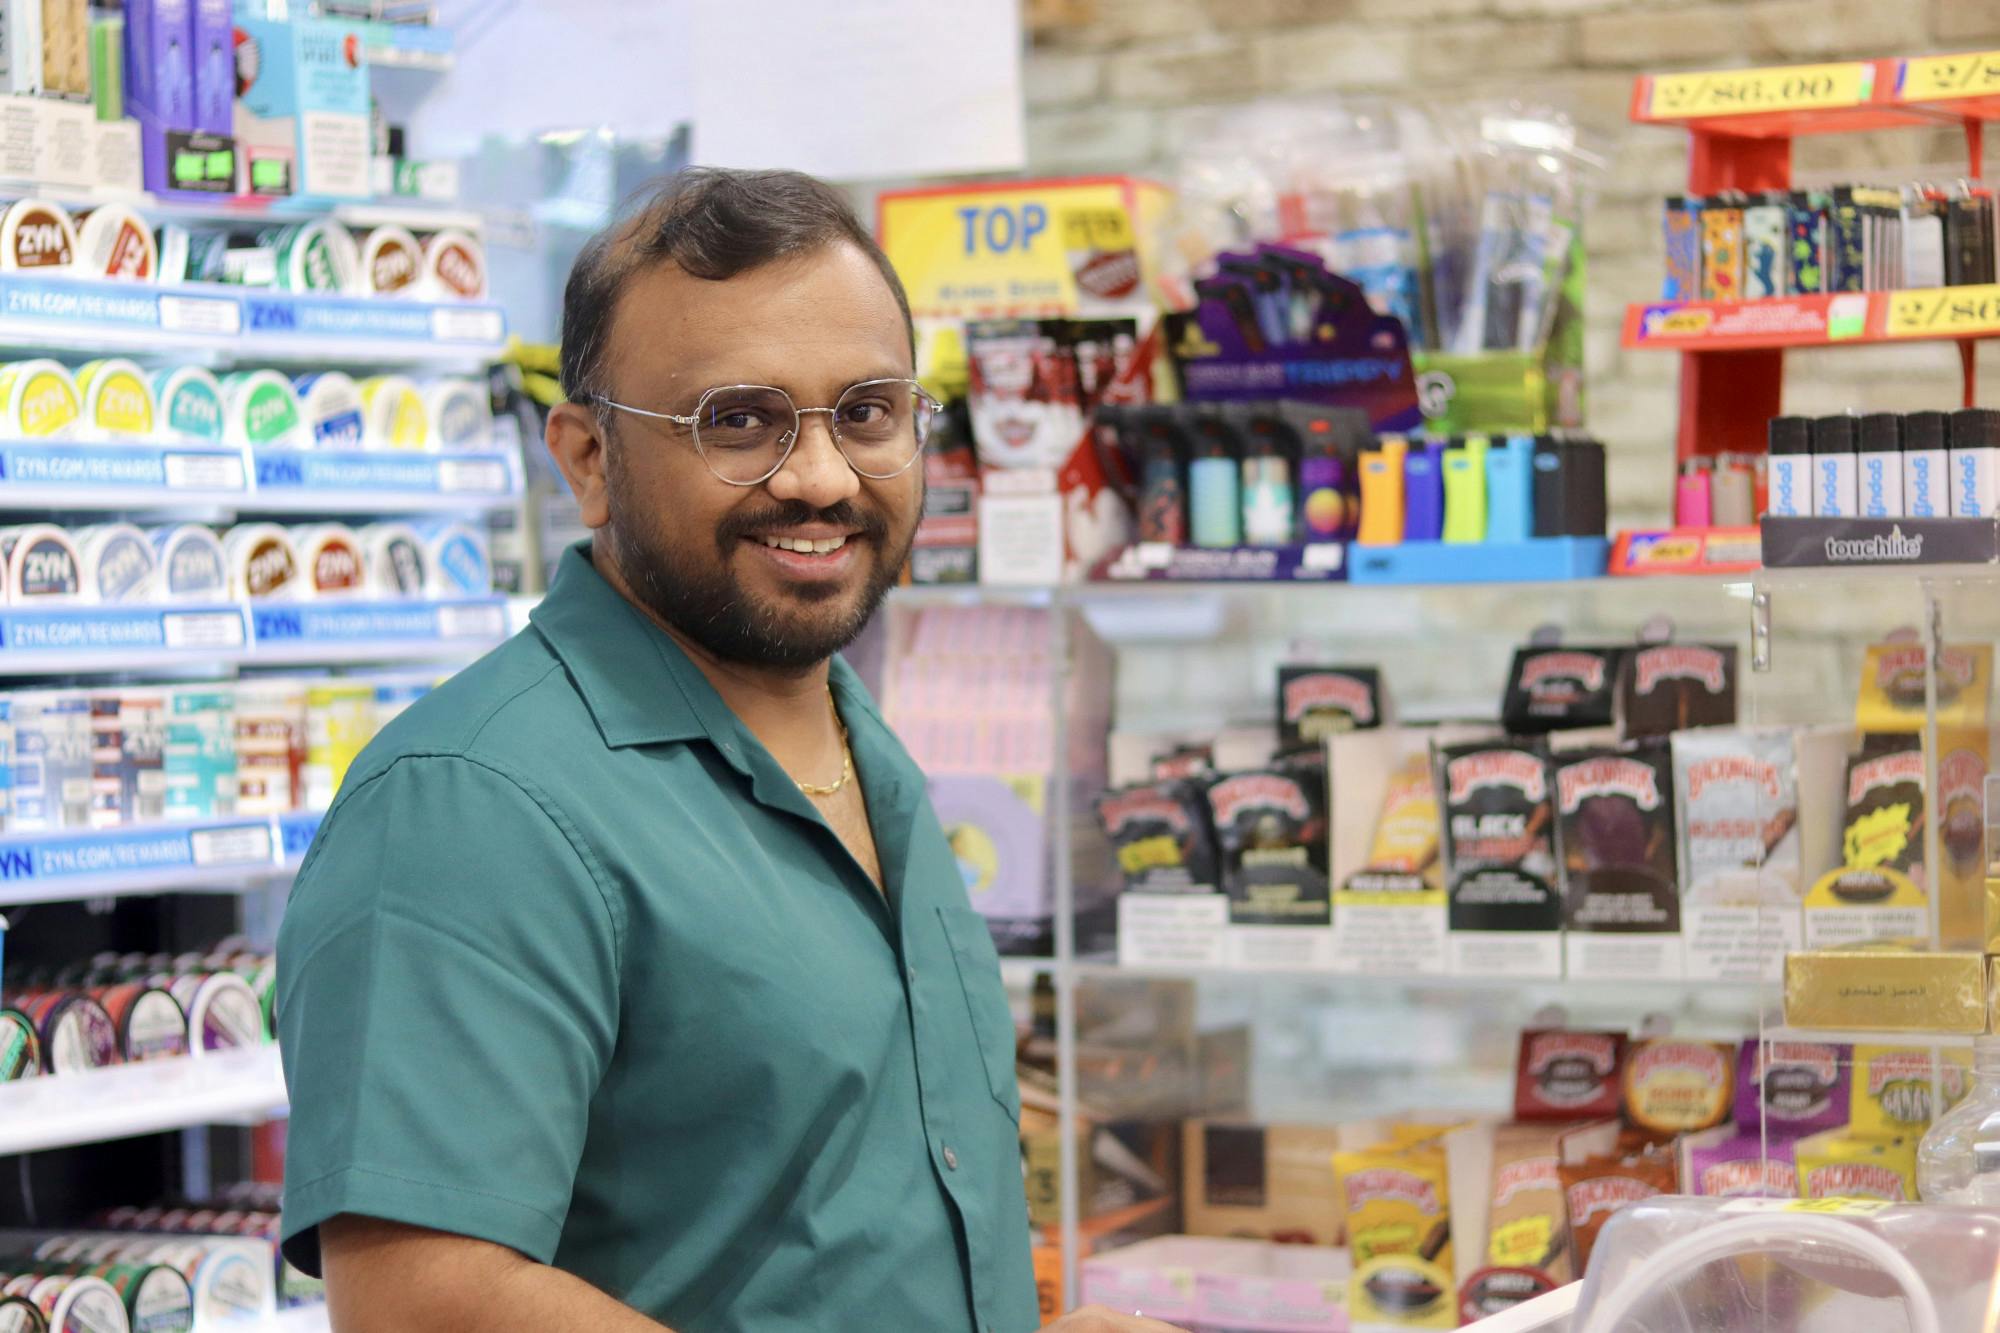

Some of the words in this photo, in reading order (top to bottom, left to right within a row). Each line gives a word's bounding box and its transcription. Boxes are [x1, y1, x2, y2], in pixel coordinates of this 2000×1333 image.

[17, 223, 65, 254] ZYN
[957, 203, 1048, 256] TOP
[1825, 532, 1923, 561] touchlite
[26, 549, 70, 582] ZYN
[0, 850, 33, 878] YN
